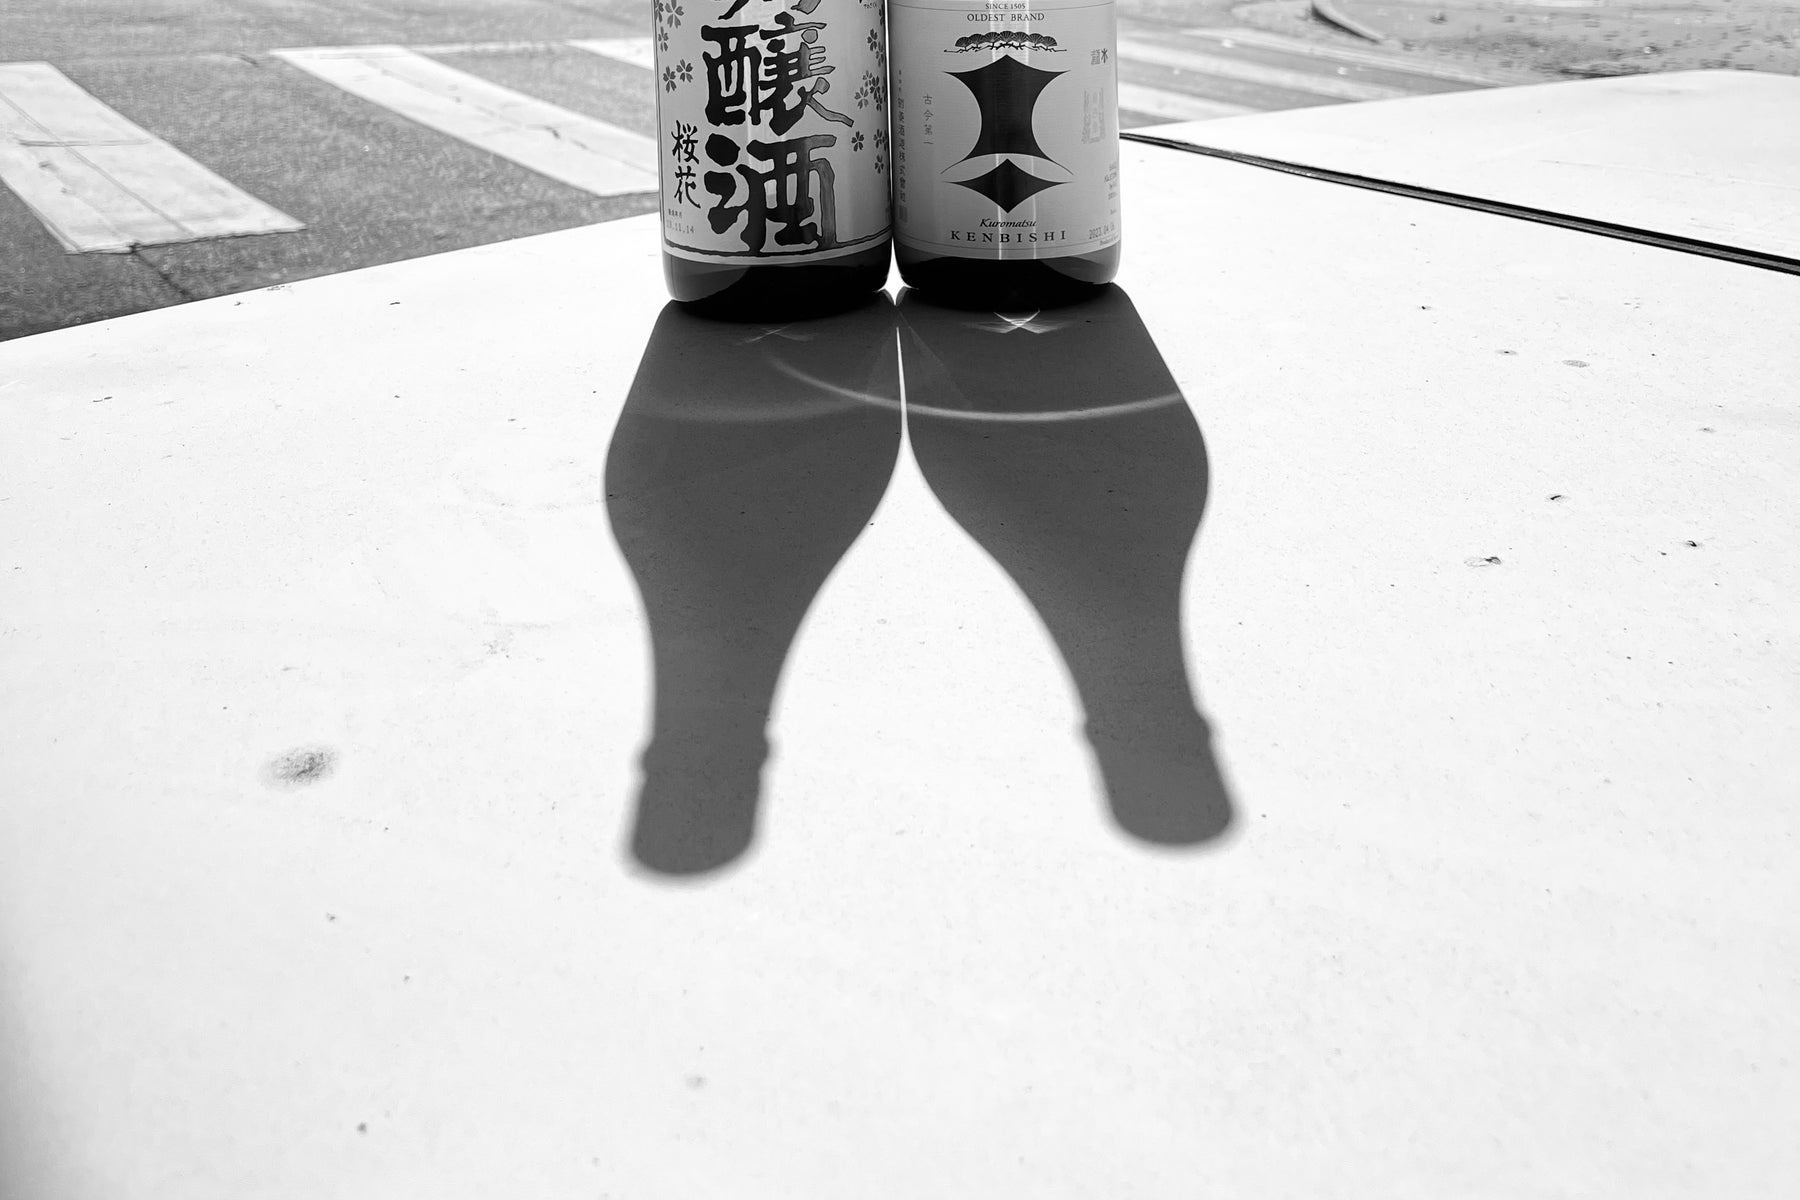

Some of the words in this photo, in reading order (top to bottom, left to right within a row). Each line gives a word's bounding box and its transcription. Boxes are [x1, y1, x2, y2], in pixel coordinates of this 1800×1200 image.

[985, 2, 1009, 10] SINCE
[1010, 2, 1026, 10] 1505
[966, 13, 1005, 22] OLDEST
[1010, 12, 1045, 22] BRAND
[671, 120, 702, 209] 桜花
[980, 218, 1037, 228] Kuromatsu
[950, 230, 1066, 243] KENBISHI
